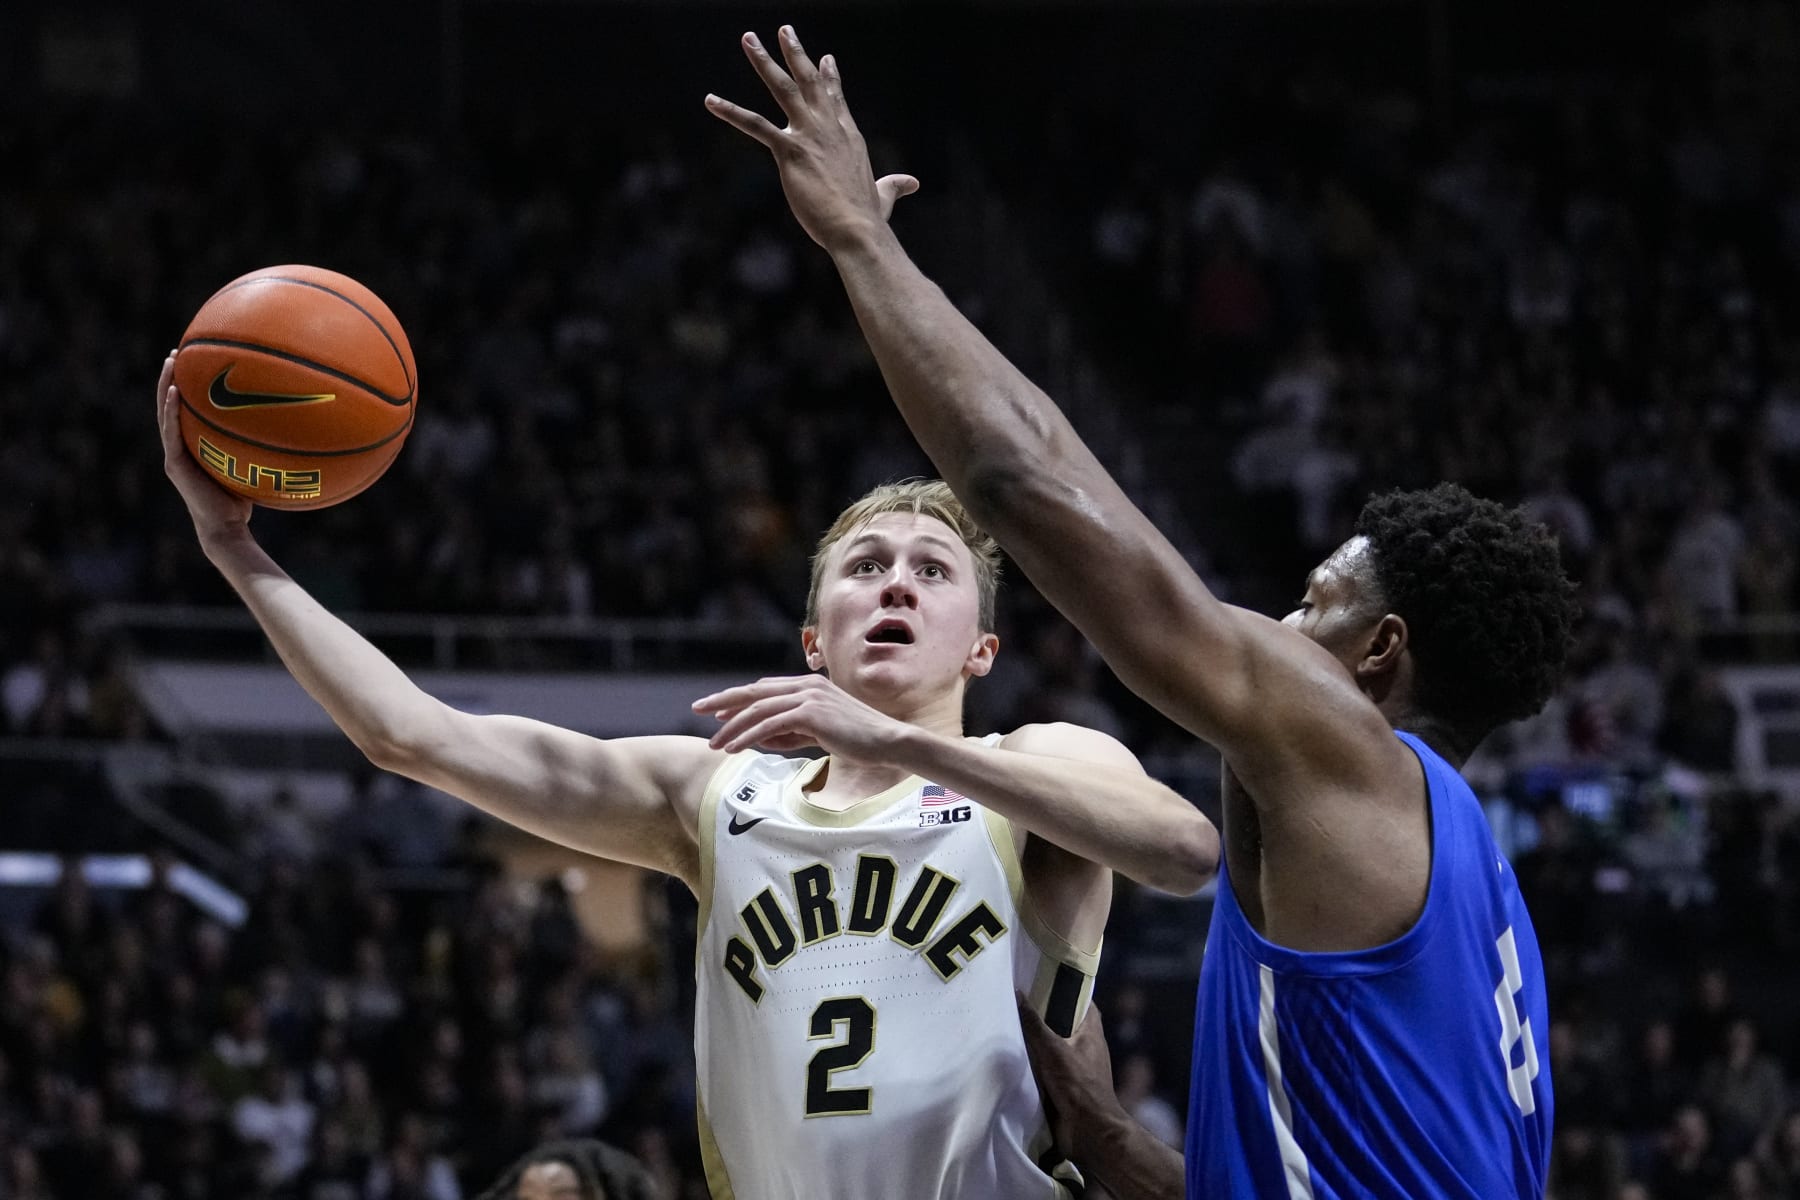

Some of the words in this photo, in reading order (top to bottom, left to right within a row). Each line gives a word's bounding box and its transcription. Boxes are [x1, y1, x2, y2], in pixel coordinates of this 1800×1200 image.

[198, 435, 320, 493] ELITE
[723, 853, 1009, 1009] PURDUE
[803, 994, 877, 1119] 2
